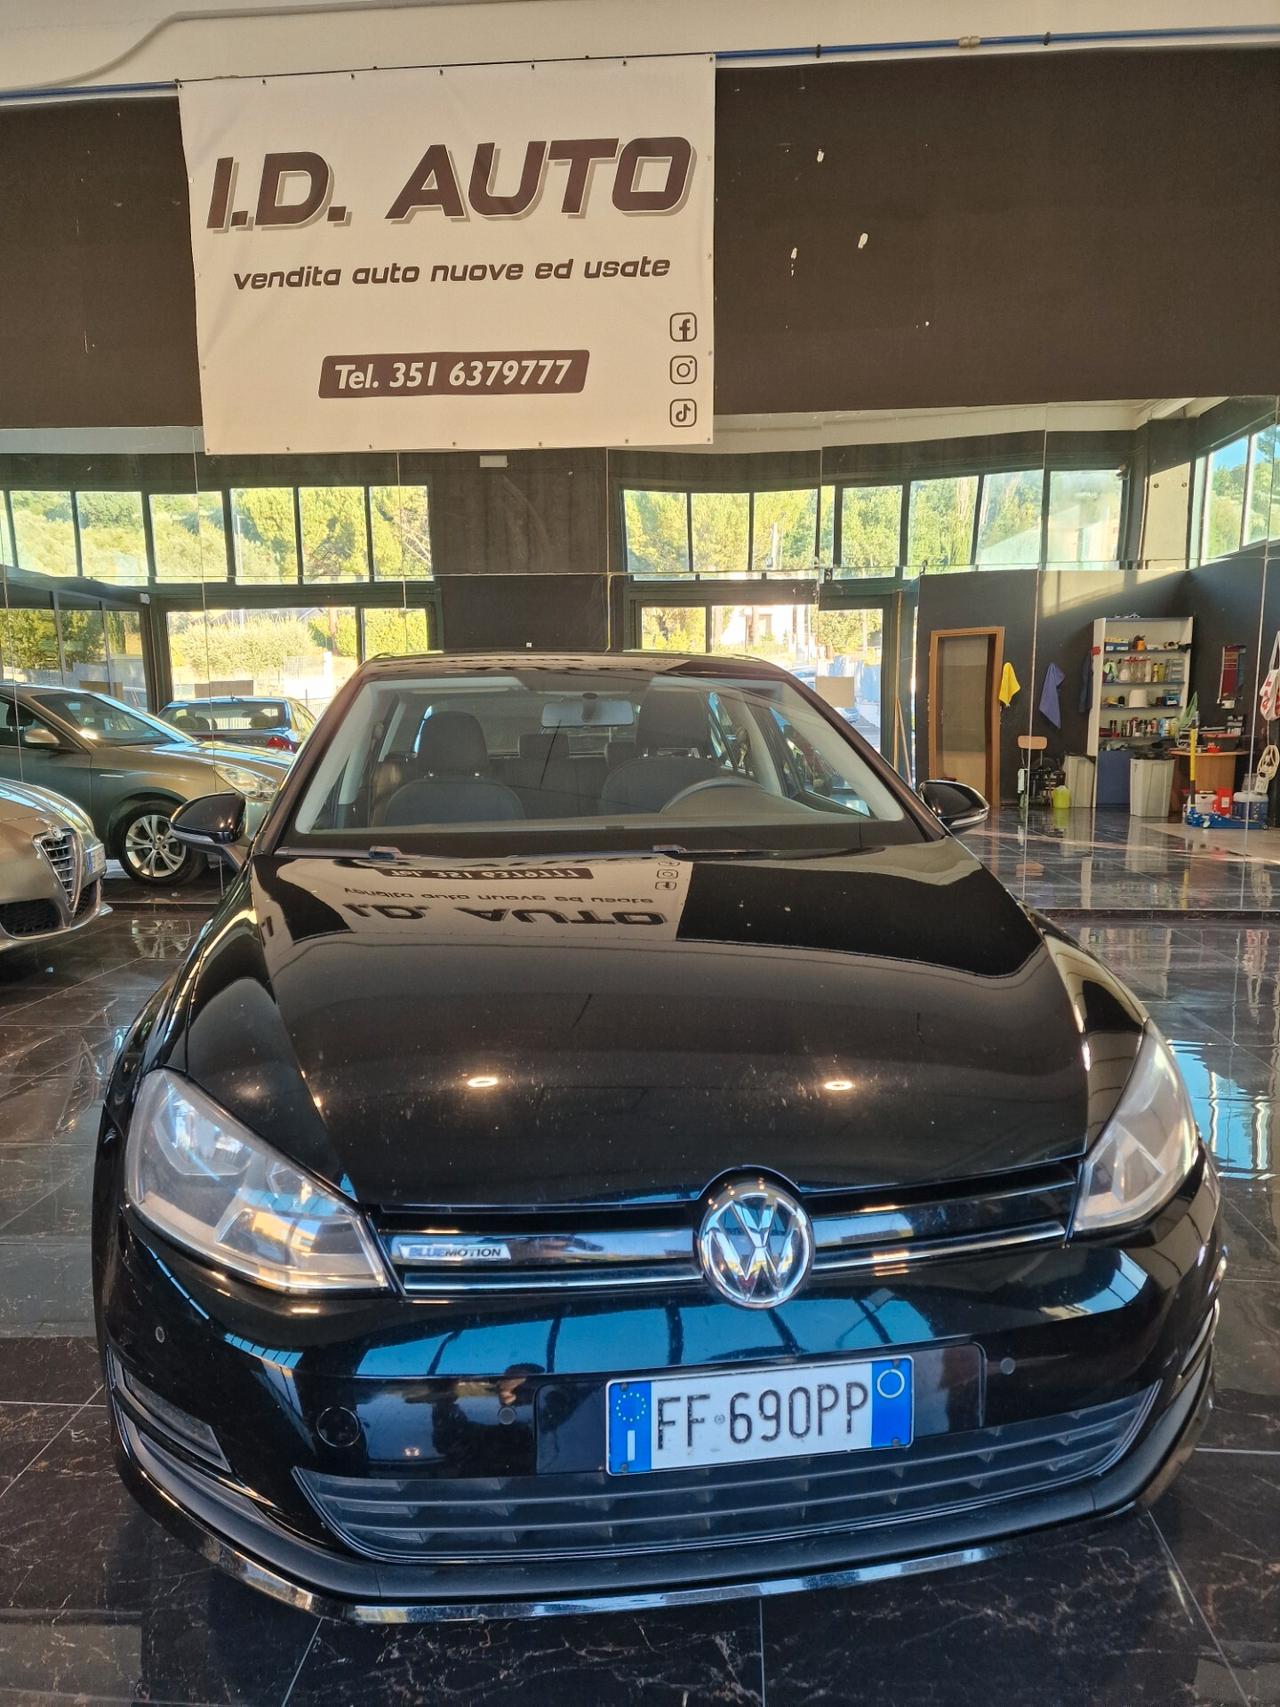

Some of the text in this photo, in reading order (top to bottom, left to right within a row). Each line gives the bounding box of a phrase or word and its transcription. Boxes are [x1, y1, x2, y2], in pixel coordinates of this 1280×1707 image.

[206, 136, 696, 231] I.D. AUTO
[233, 255, 670, 290] vendita auto nuove ed usate
[334, 359, 572, 390] Tel. 351 6379777
